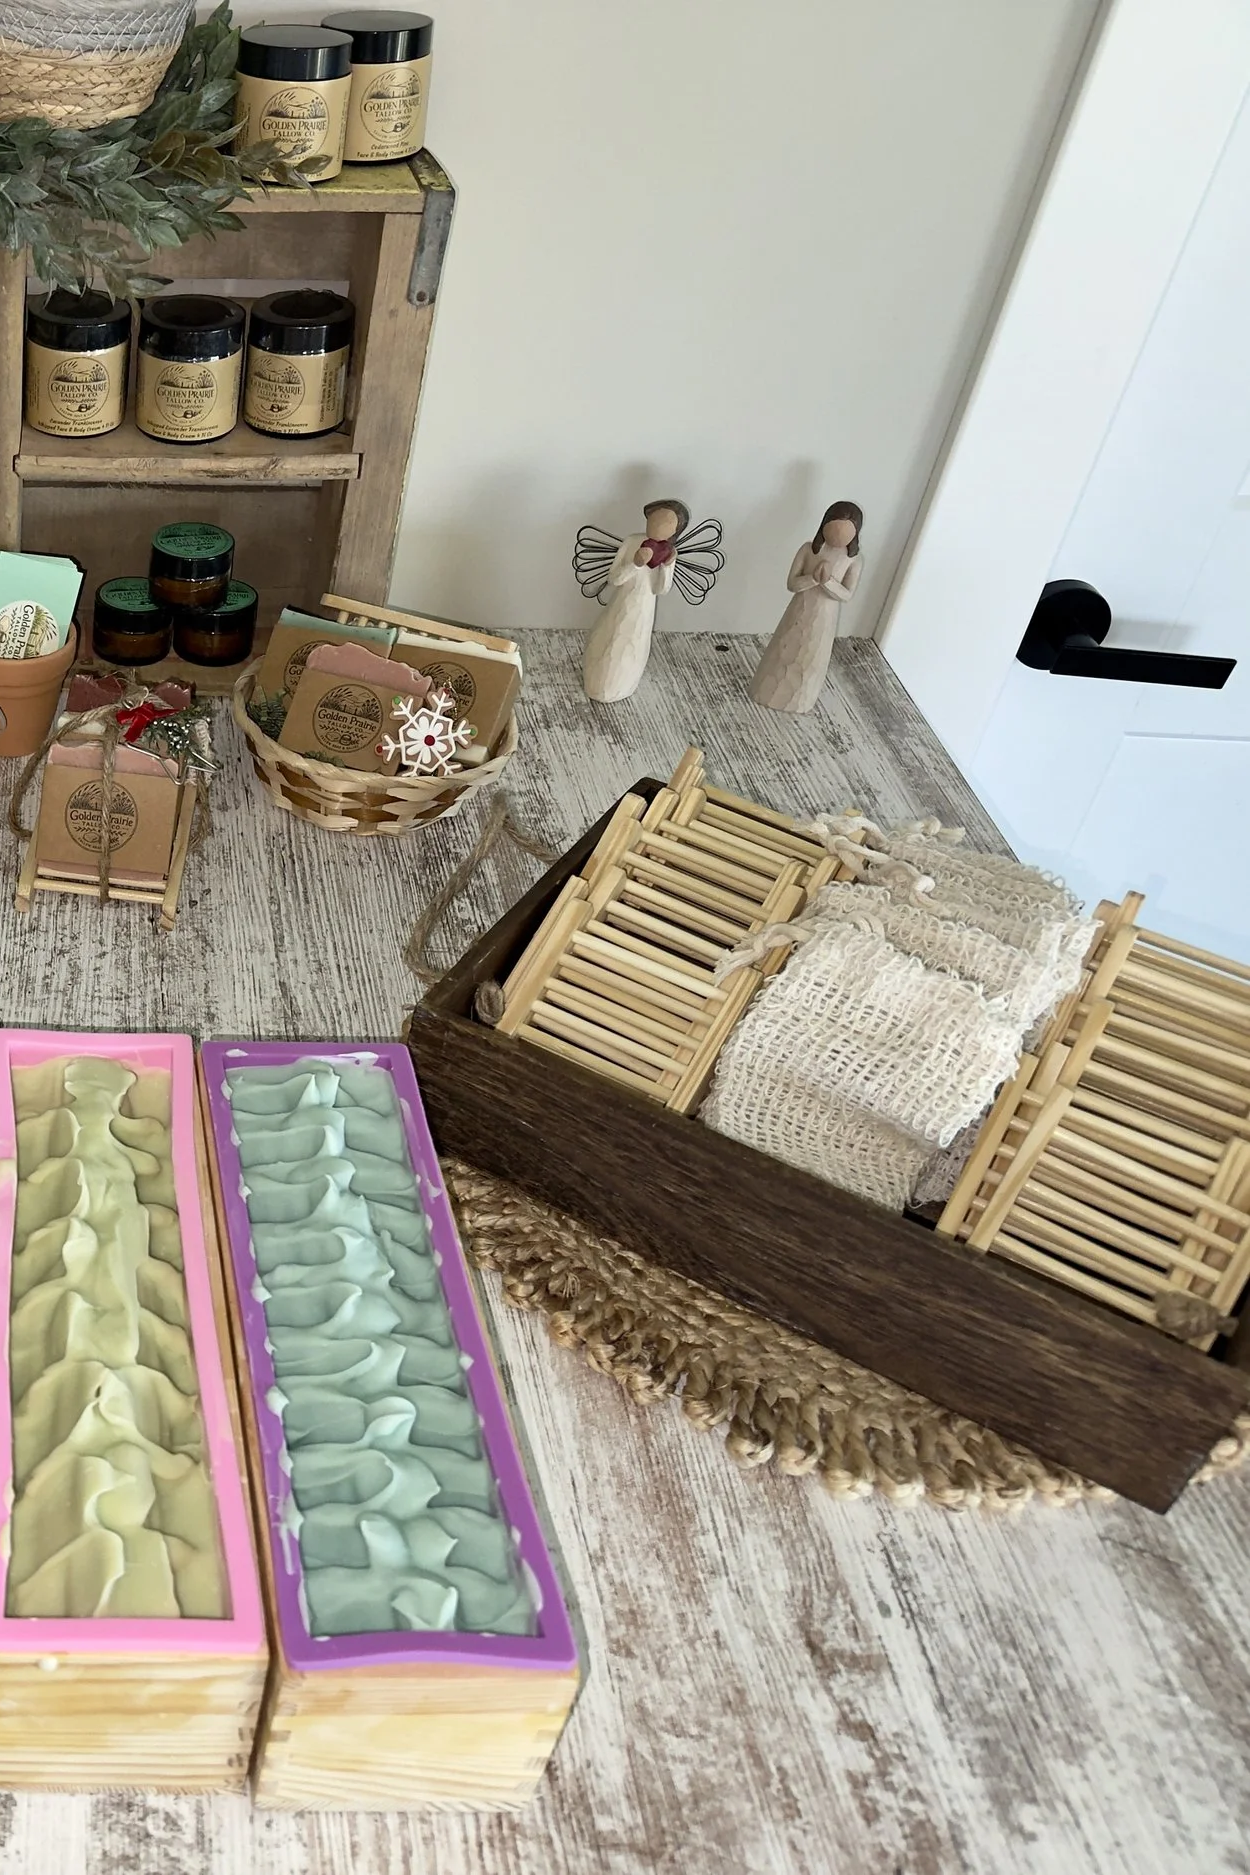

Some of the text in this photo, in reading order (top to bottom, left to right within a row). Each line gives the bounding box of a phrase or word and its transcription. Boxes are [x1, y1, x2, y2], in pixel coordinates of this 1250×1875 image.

[363, 100, 397, 112] GOLDEN
[262, 119, 327, 131] GOLDEN PRAIRIE
[51, 382, 107, 393] GOLDEN PRAIRIE
[157, 386, 214, 399] GOLDEN PRAIRIE
[274, 385, 302, 395] PRAIRIE
[12, 616, 21, 643] TALLOW
[12, 604, 34, 659] Golden Prai
[318, 708, 377, 732] Golden Prairie
[328, 720, 352, 730] TALLOW
[70, 809, 134, 827] Golden rairie
